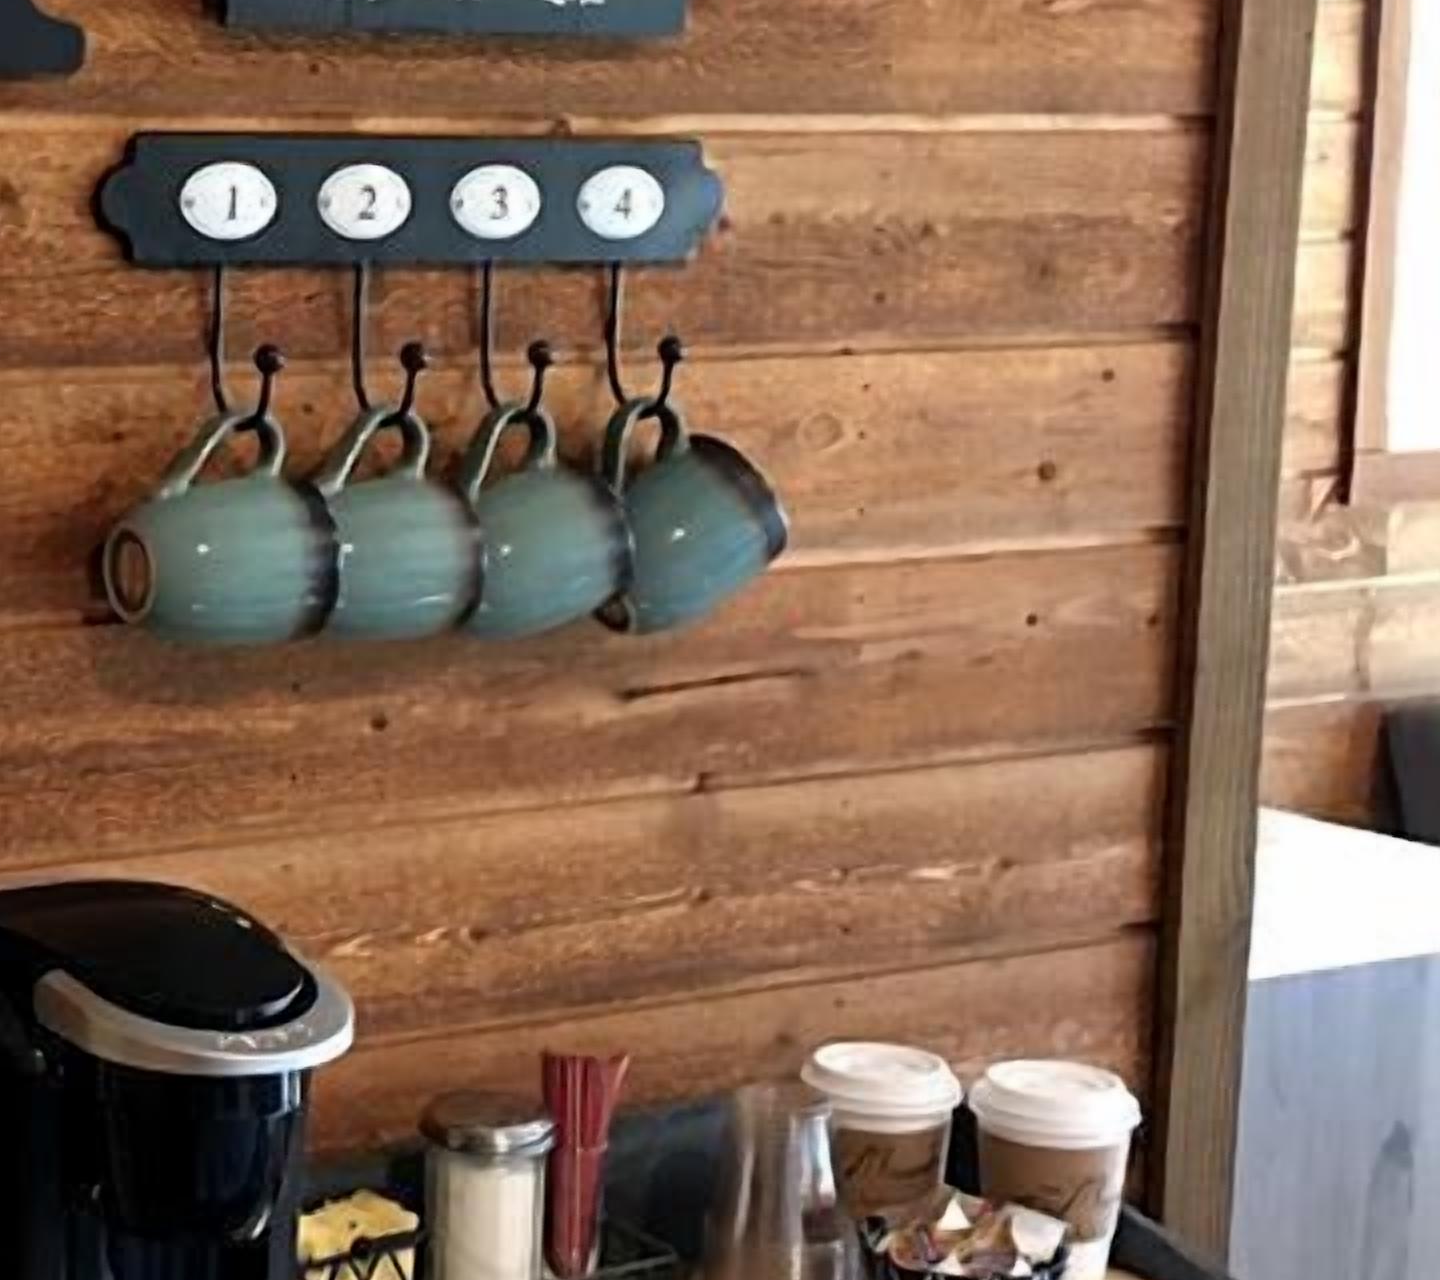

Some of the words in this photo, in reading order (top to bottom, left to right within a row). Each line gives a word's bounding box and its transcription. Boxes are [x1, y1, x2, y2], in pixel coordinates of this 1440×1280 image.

[227, 184, 238, 221] 1
[359, 183, 377, 221] 2
[489, 183, 509, 221] 3
[613, 187, 633, 220] 4
